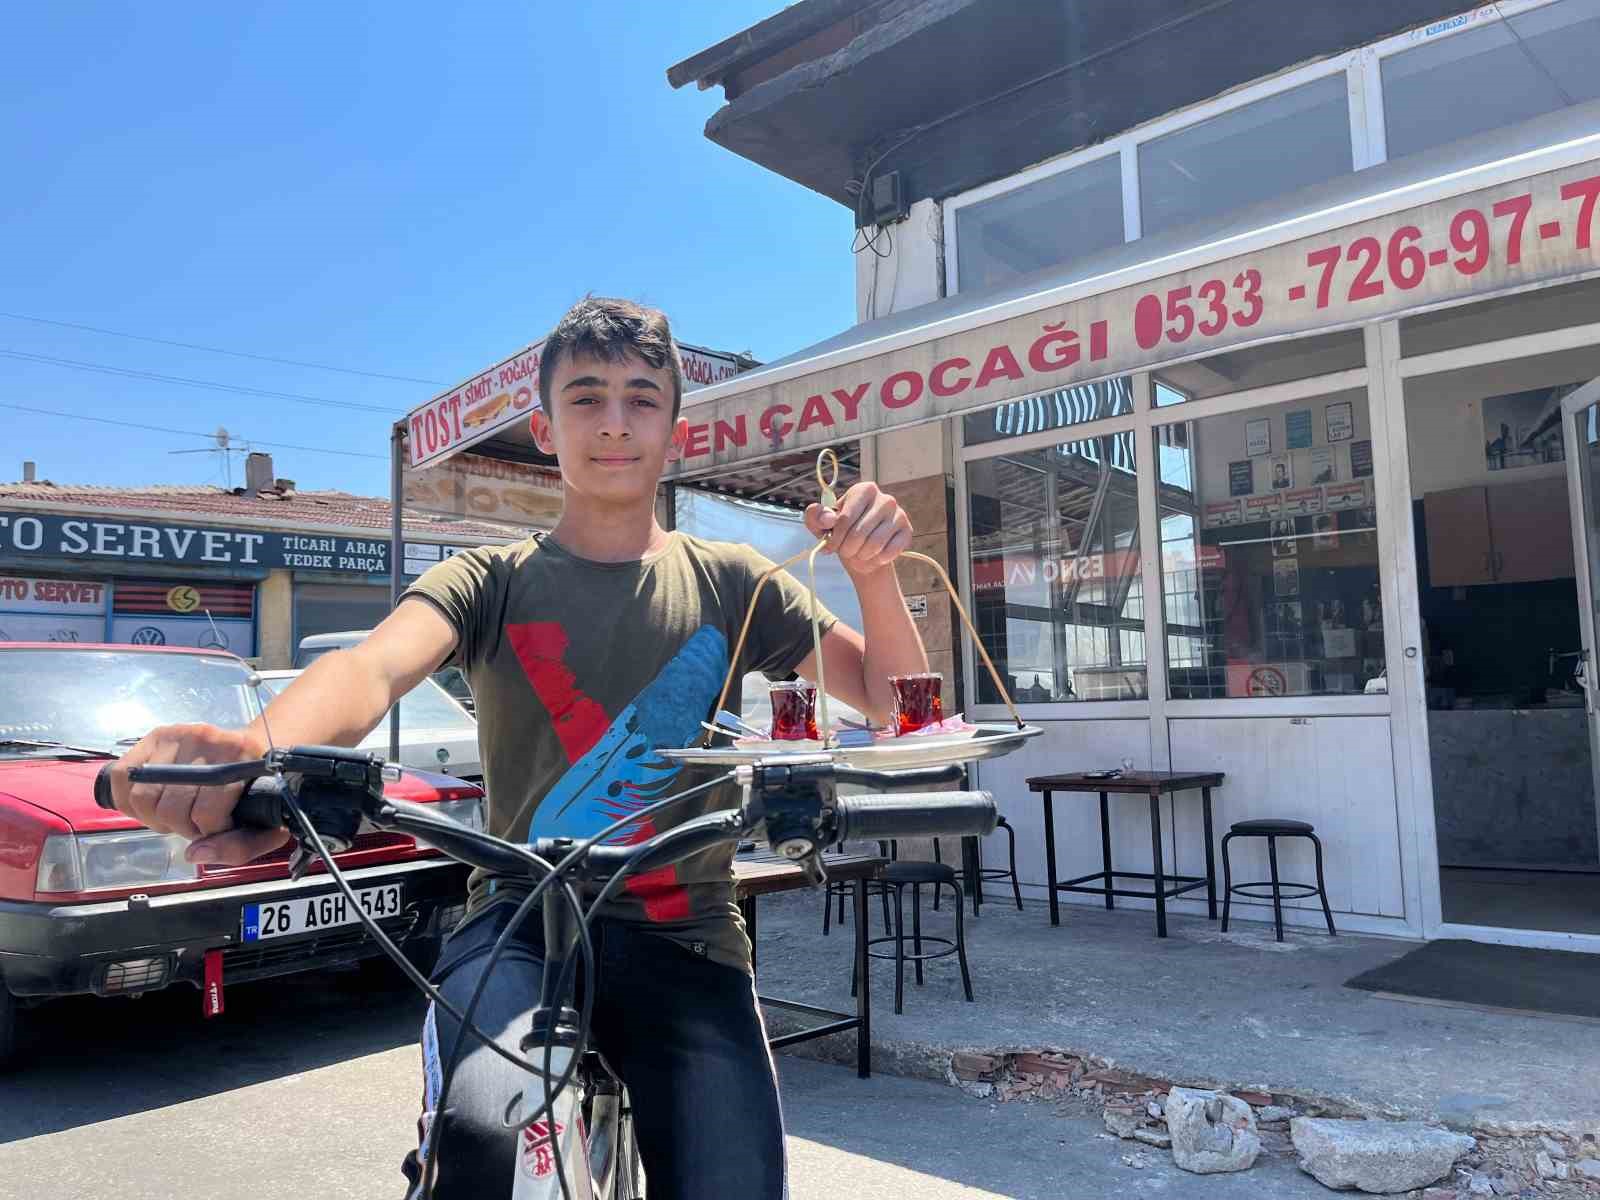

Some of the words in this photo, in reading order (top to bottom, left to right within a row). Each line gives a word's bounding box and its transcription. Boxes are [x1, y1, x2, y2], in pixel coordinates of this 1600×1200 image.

[760, 383, 871, 446] ÇAY
[880, 320, 1108, 409] OCAĞI
[1135, 269, 1263, 350] 0533
[411, 394, 462, 459] TOST
[465, 377, 492, 406] SİMİT
[60, 521, 263, 563] SERVET
[282, 536, 336, 552] TİCARİ
[345, 541, 386, 558] ARAÇ
[283, 553, 332, 568] YEDEK
[339, 557, 385, 572] PARÇA
[33, 582, 104, 604] SERVET
[262, 905, 290, 936] 26
[305, 896, 346, 927] AGH
[361, 888, 397, 916] 543
[246, 926, 258, 935] TR
